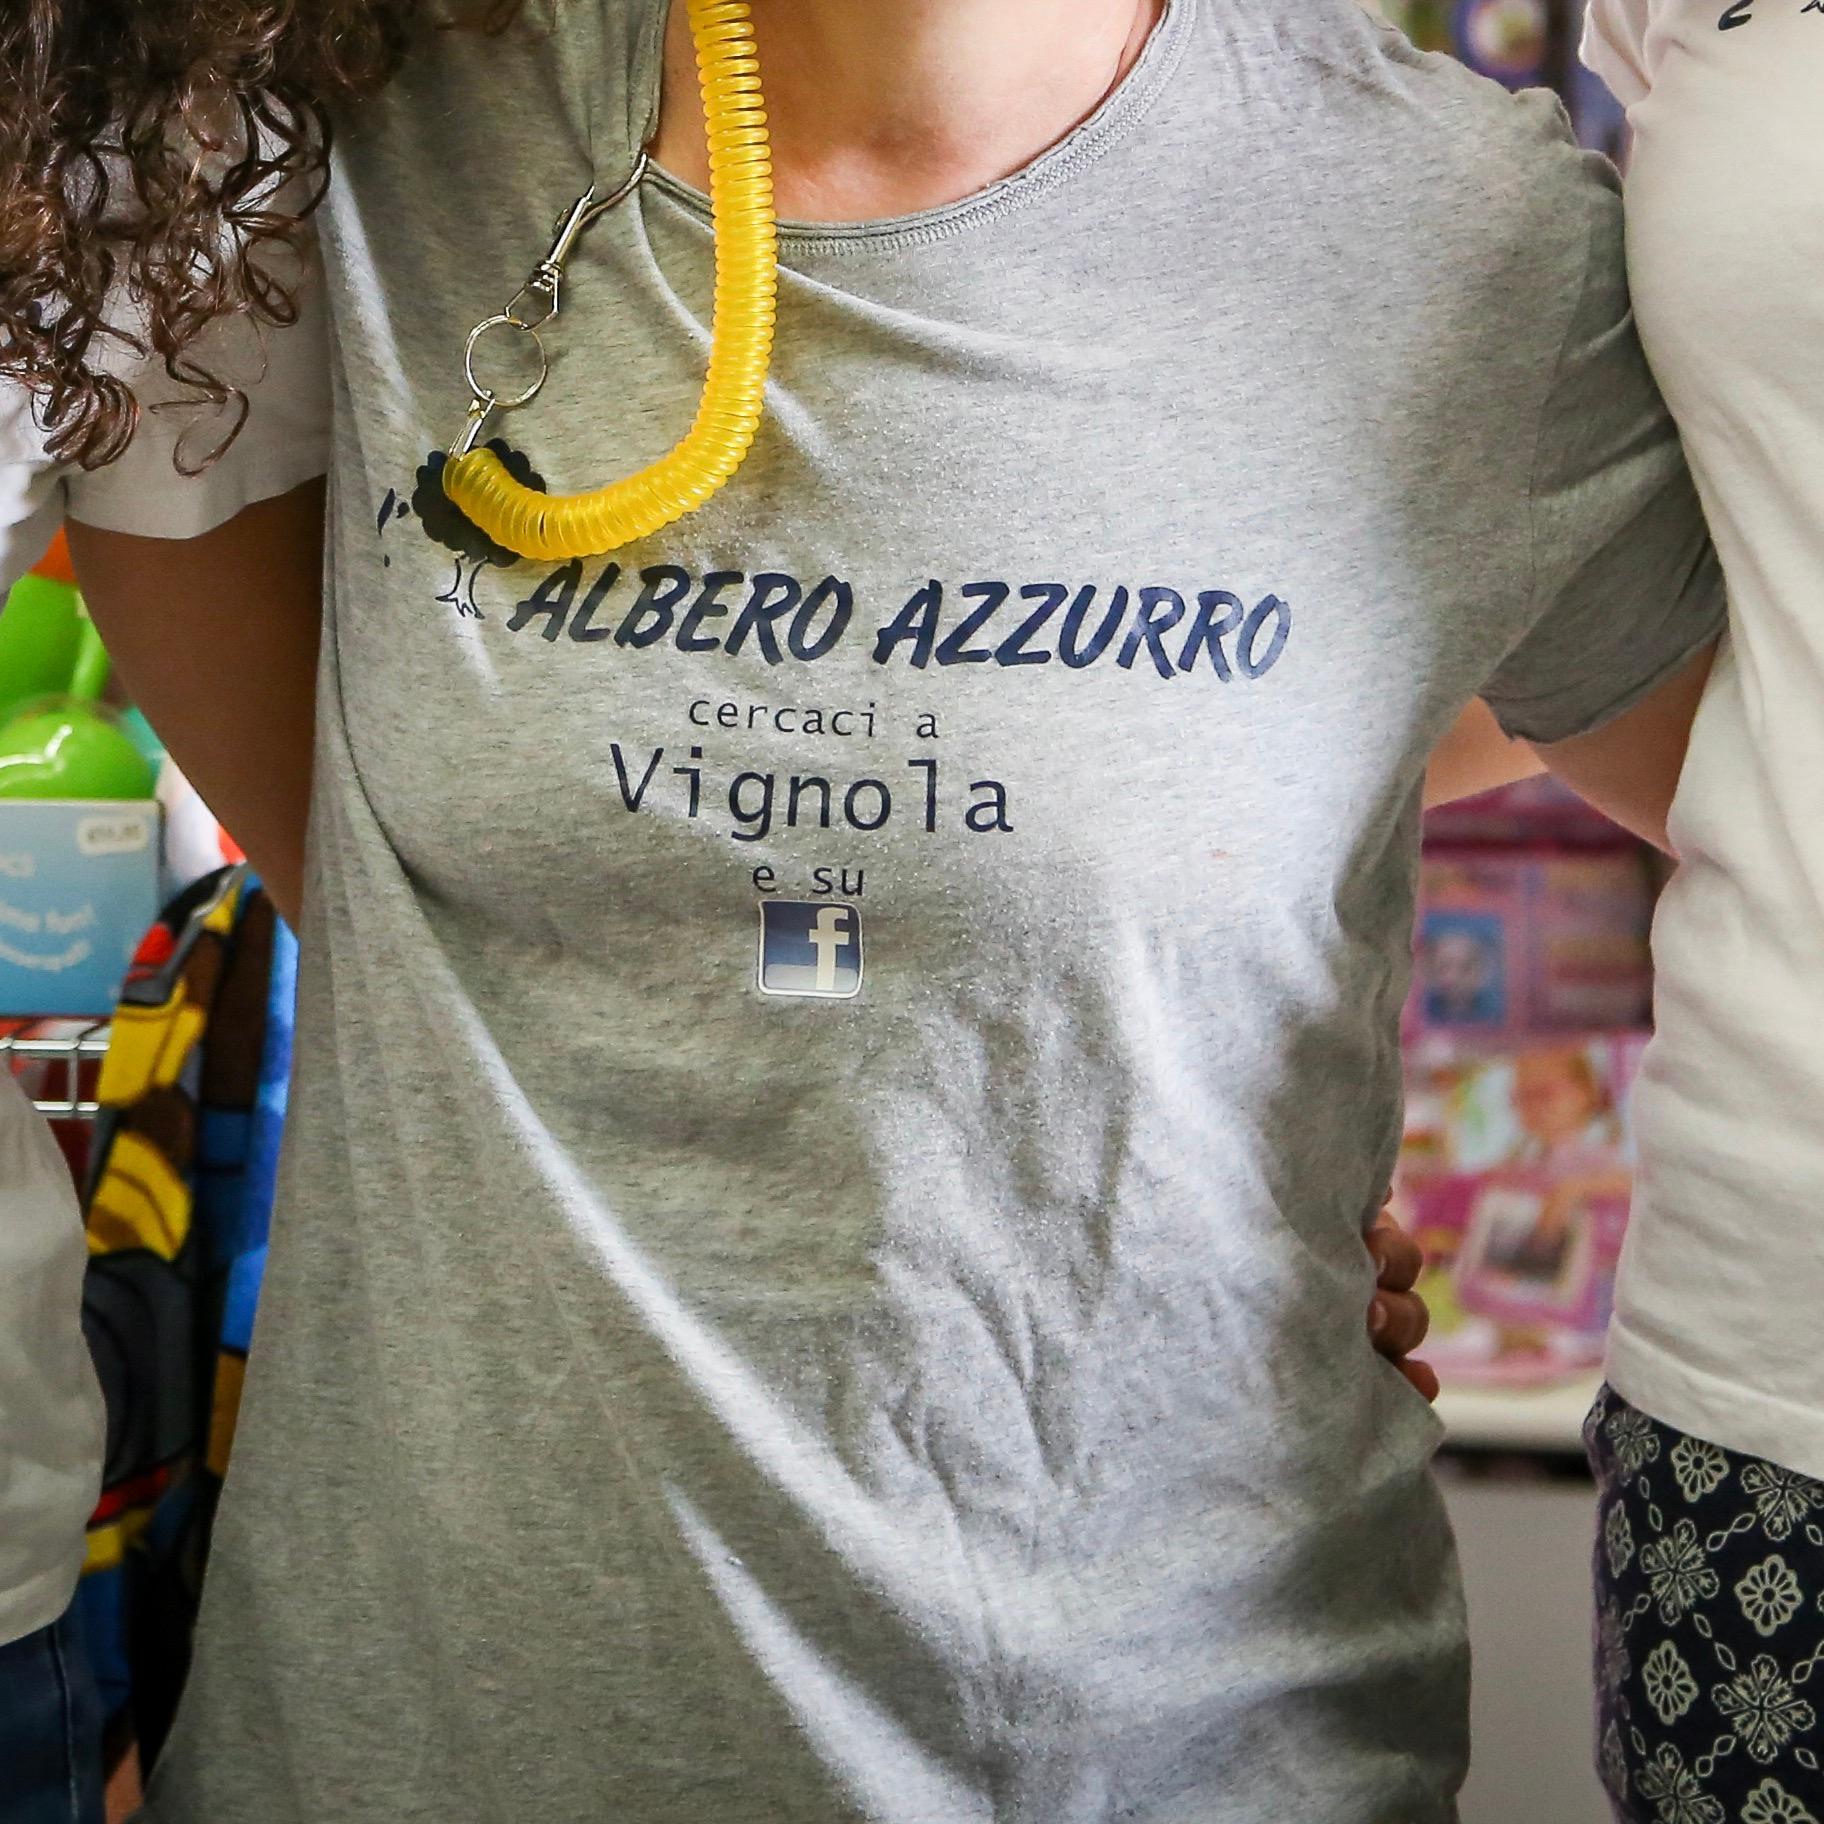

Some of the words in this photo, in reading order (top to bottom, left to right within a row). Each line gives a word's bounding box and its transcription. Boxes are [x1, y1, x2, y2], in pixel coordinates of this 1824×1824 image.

[505, 557, 854, 667] ALBERO
[872, 578, 1292, 683] AZZURRO
[688, 699, 877, 738] cercaci
[916, 712, 940, 739] a
[609, 742, 1015, 843] Vignola
[752, 864, 777, 893] e
[811, 866, 865, 896] su
